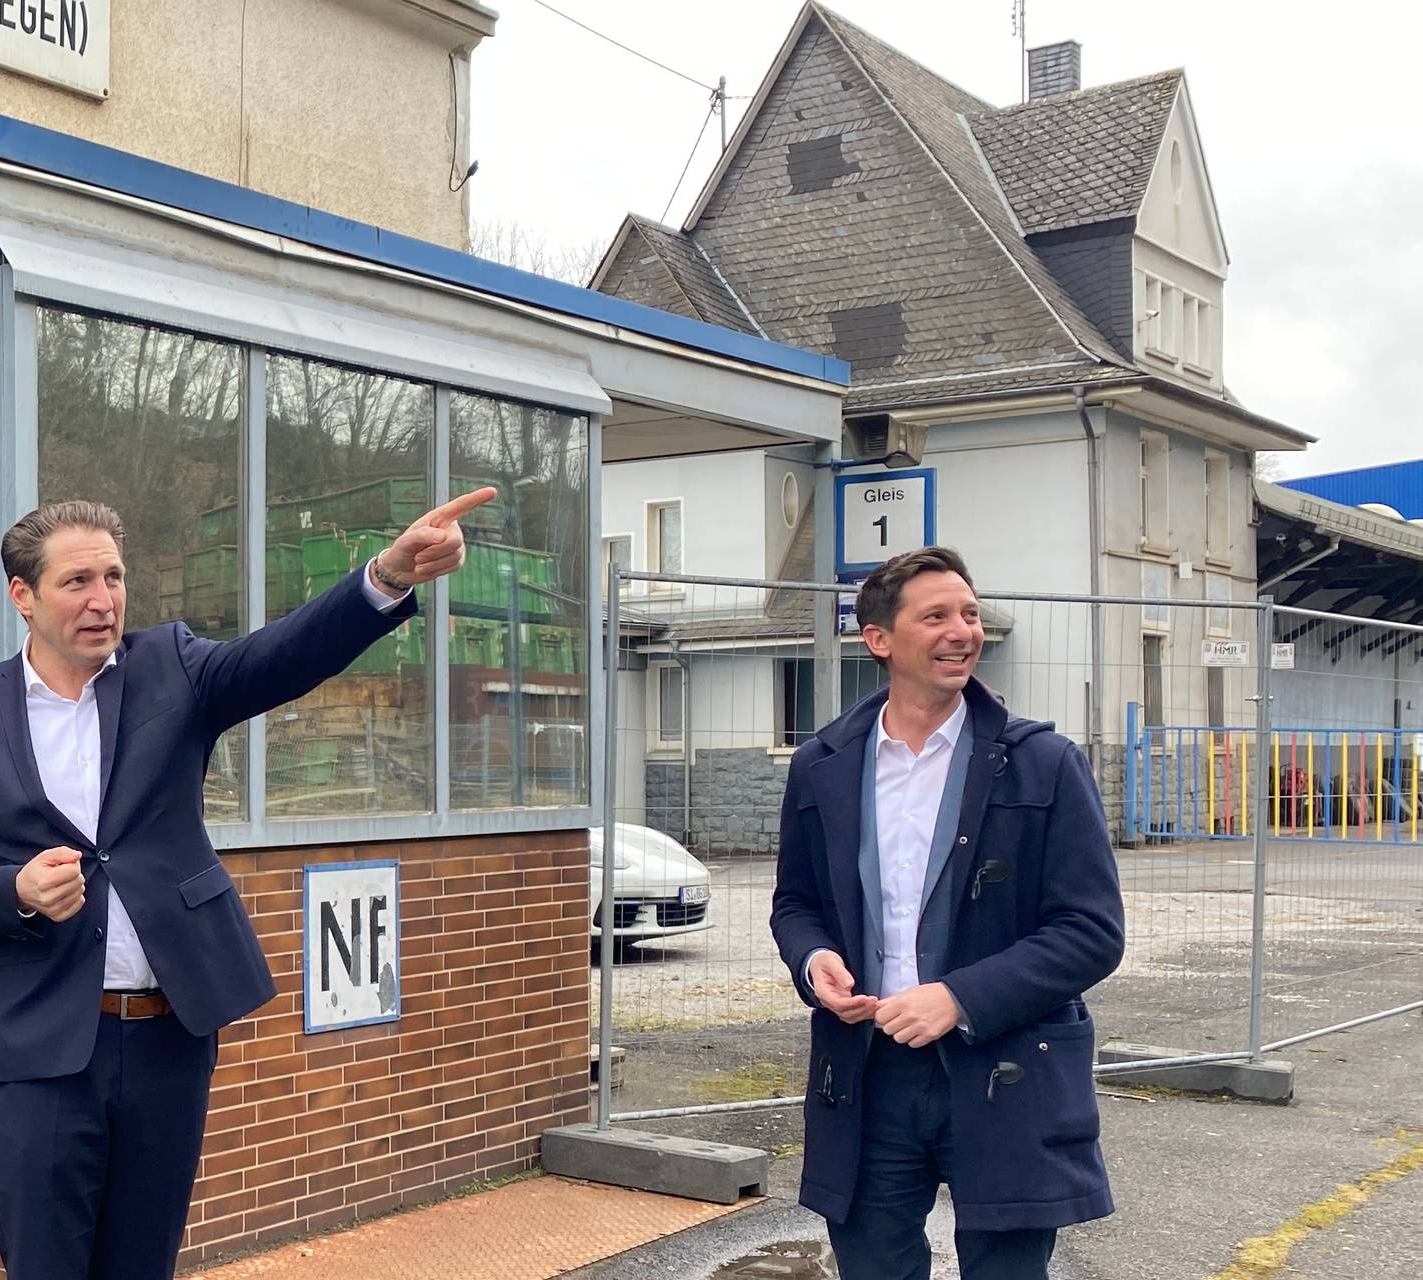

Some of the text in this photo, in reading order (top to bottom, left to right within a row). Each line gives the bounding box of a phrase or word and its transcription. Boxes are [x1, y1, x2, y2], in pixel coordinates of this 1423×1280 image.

[864, 487, 905, 503] Gleis
[872, 515, 888, 546] 1
[1214, 645, 1238, 655] HMR
[320, 895, 387, 992] NF
